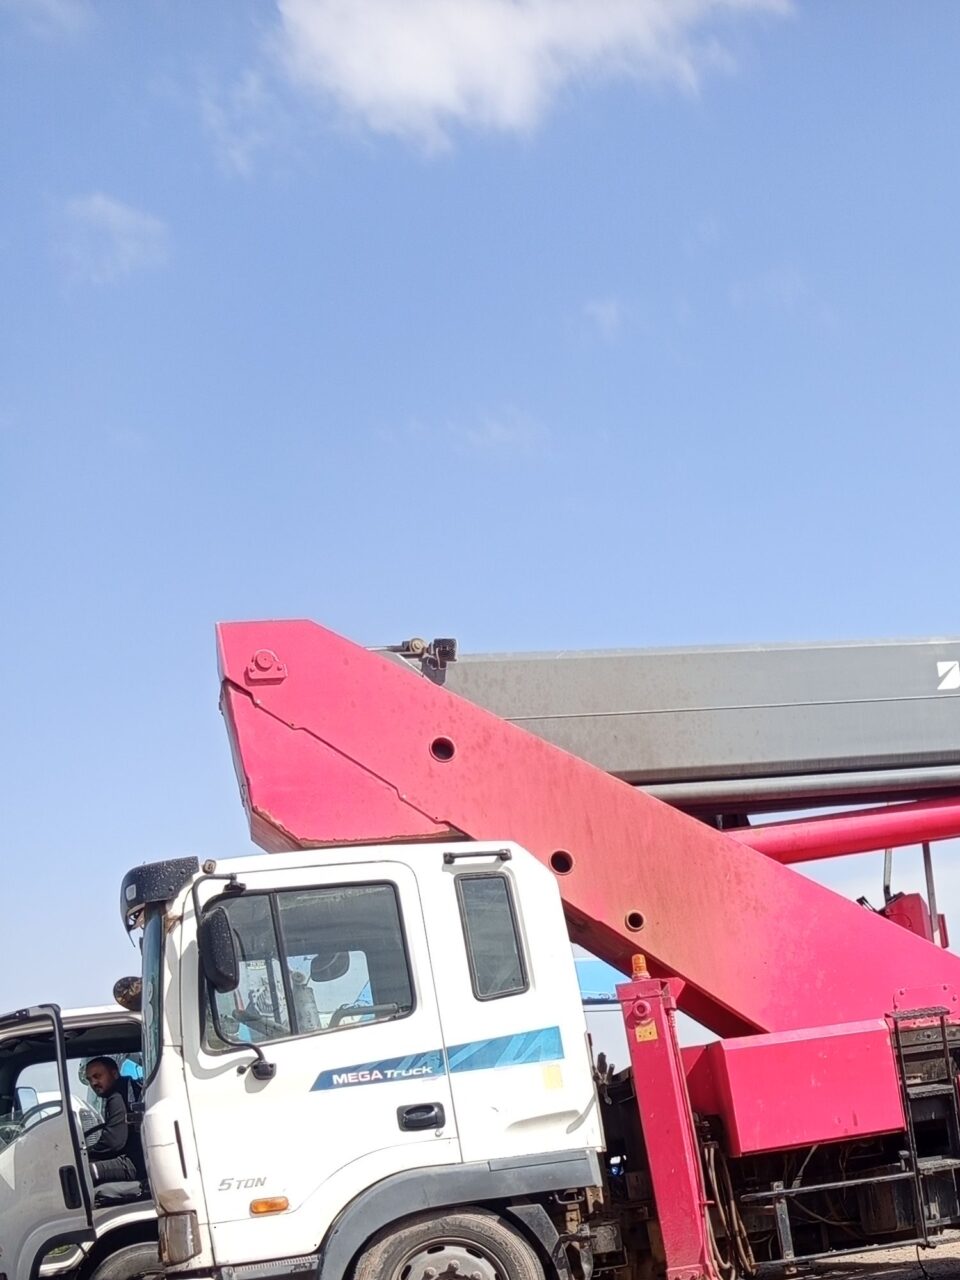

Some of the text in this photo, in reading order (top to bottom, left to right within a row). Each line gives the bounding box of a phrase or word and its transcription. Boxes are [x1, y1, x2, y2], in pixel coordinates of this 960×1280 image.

[332, 1070, 383, 1085] MEGA
[218, 1177, 267, 1191] 5 TON
